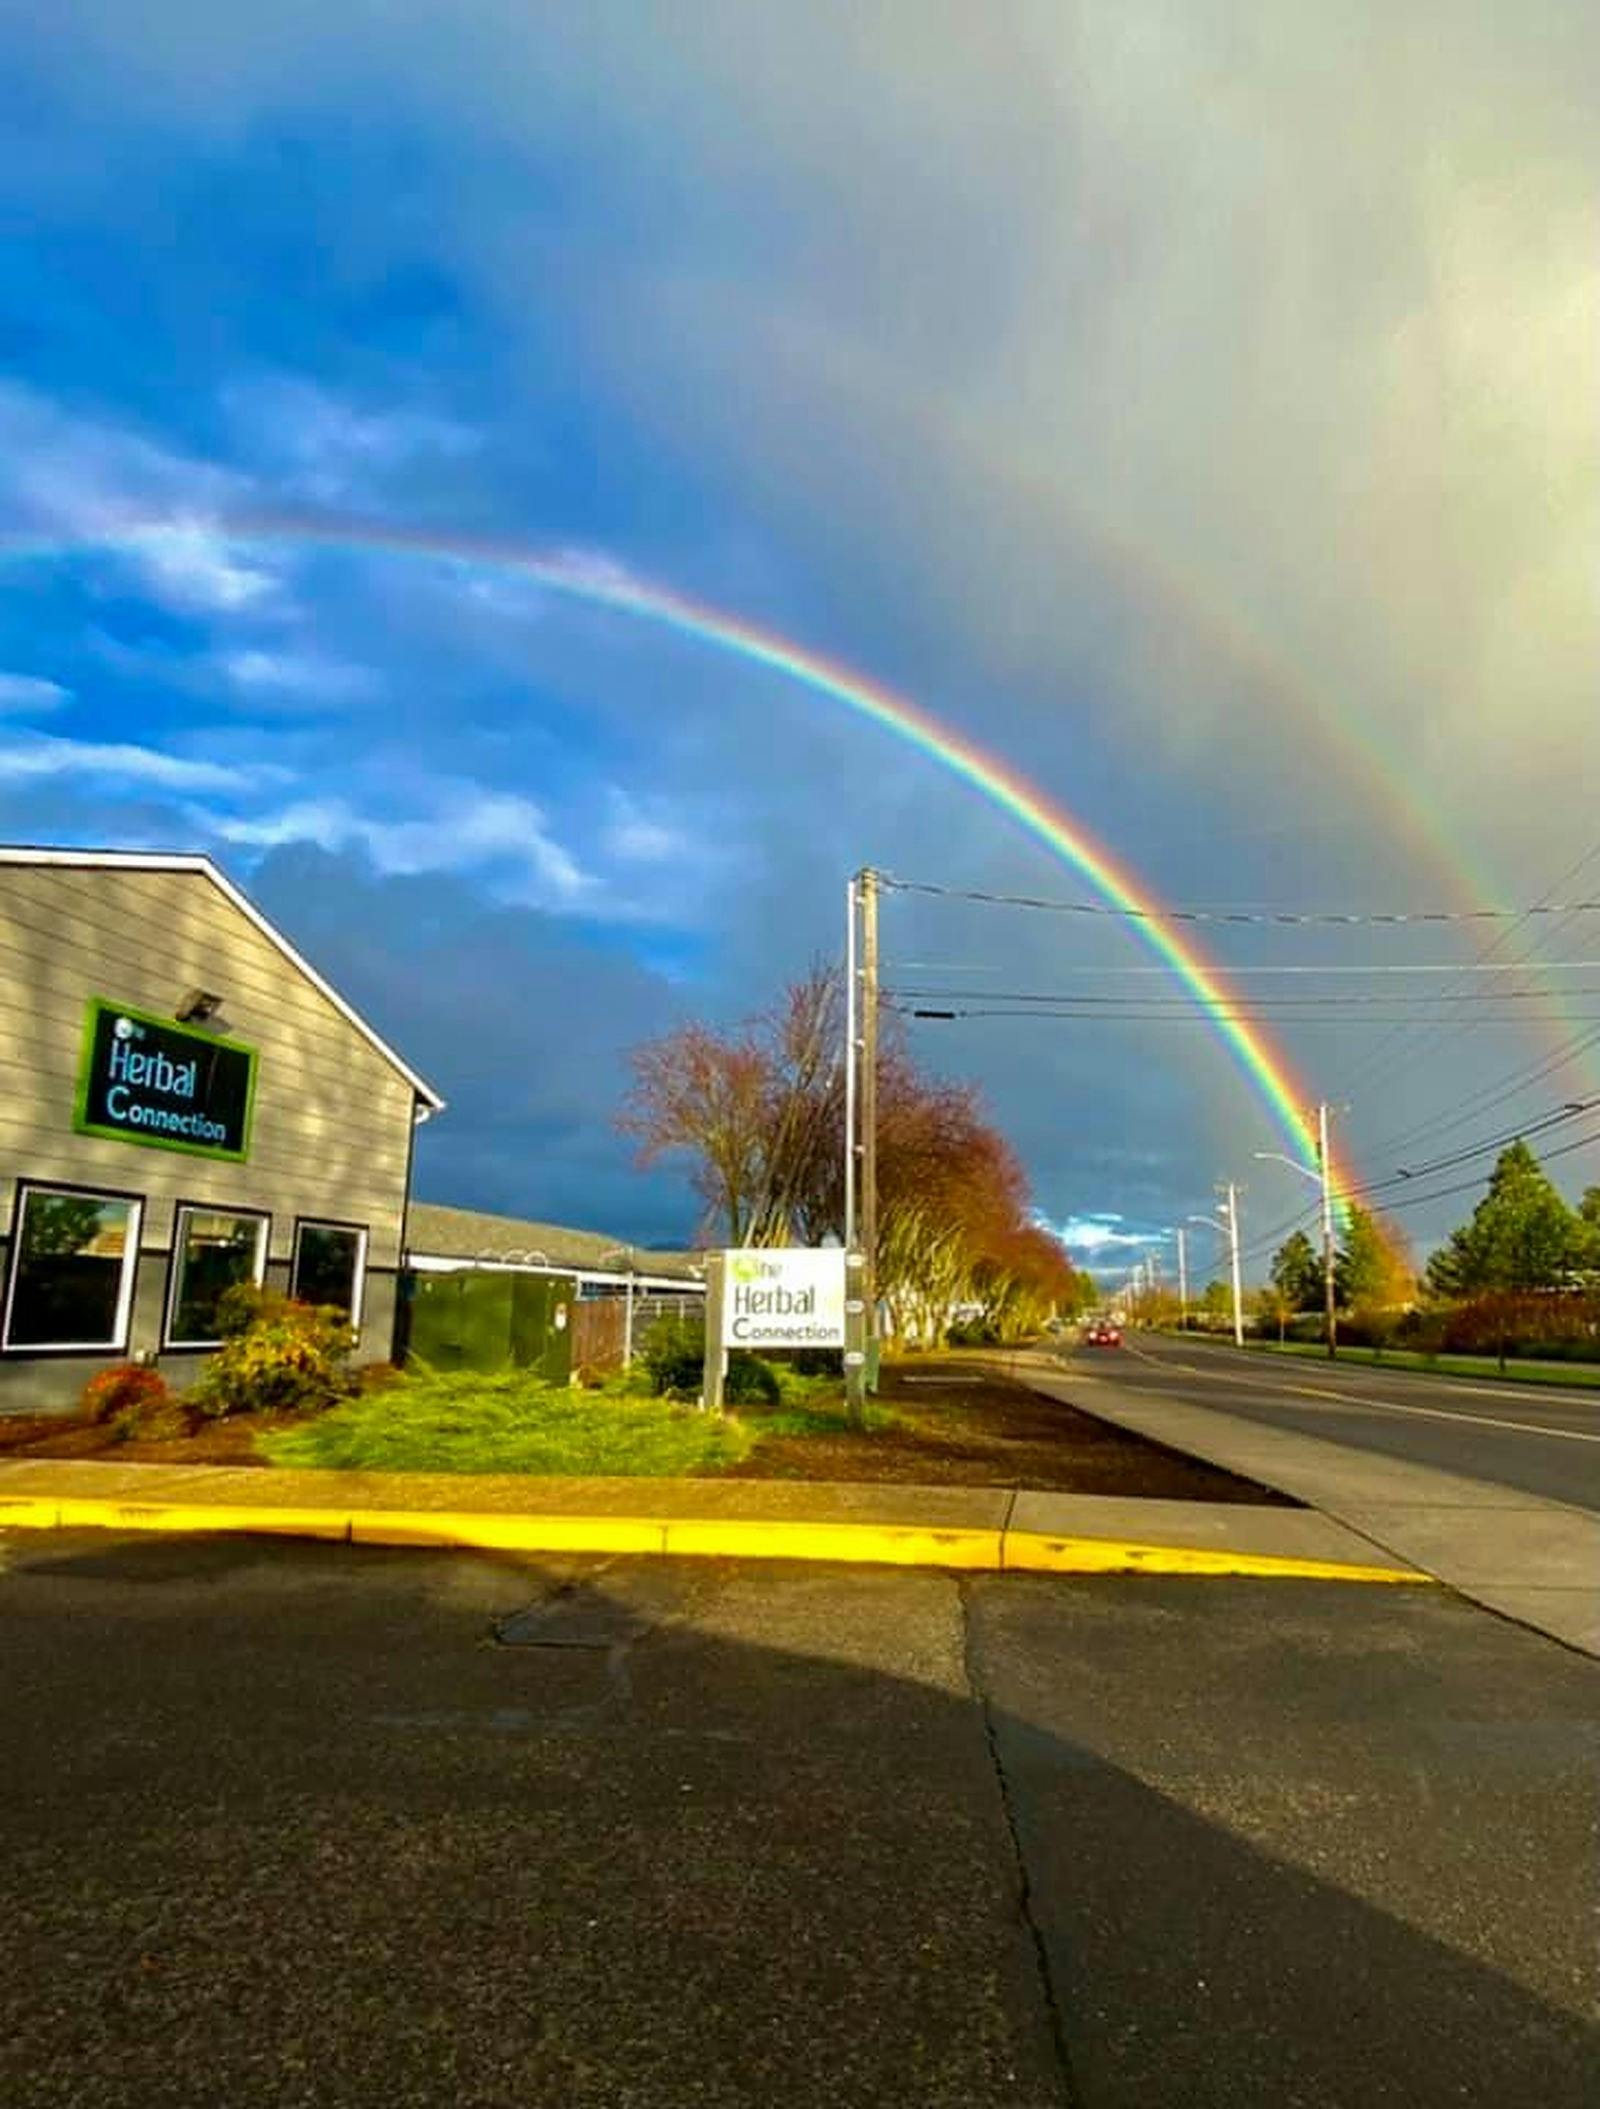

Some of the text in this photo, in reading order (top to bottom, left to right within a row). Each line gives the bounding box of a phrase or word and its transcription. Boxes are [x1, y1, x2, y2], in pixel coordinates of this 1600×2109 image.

[109, 1039, 197, 1098] Herbal
[106, 1086, 227, 1141] Connection
[734, 1285, 816, 1315] Herbal
[732, 1317, 840, 1340] Connection
